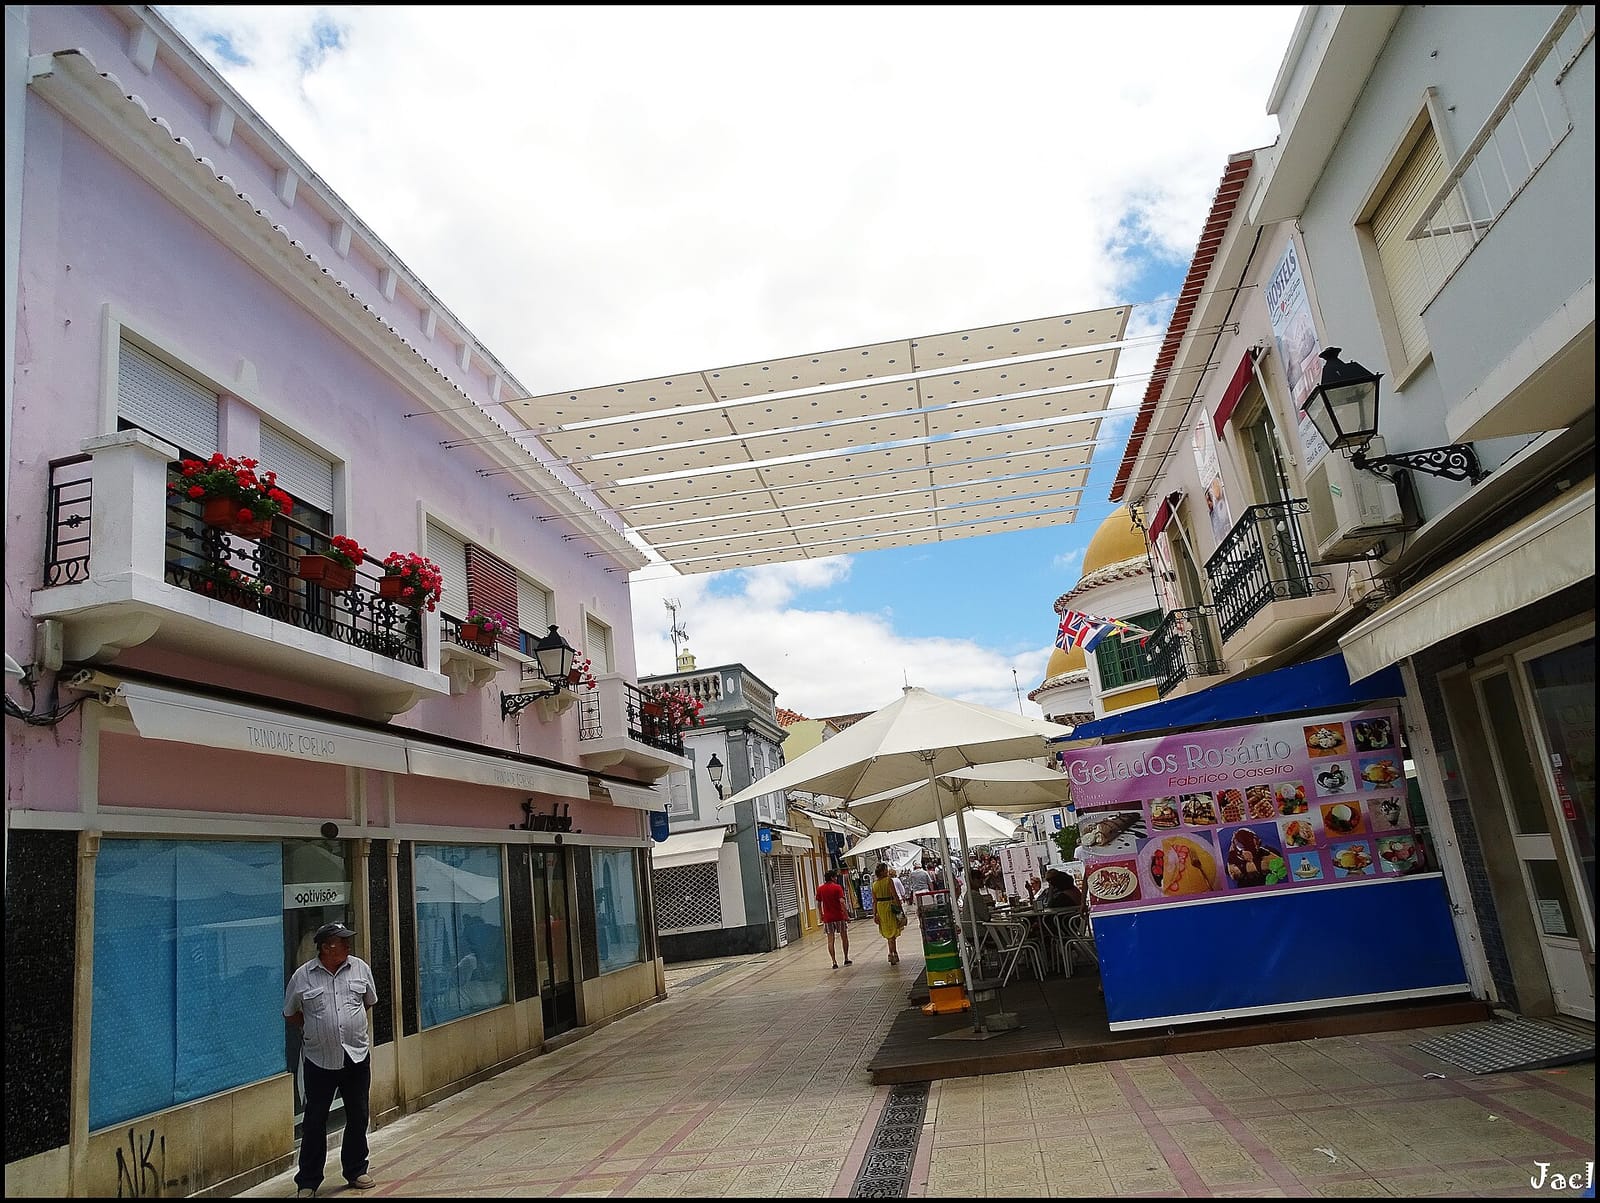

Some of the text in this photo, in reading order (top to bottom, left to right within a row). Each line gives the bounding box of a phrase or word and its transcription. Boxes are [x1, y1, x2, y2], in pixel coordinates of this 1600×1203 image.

[1266, 248, 1297, 317] HOSTELS
[246, 726, 336, 757] TRINDADE COELHO
[1068, 737, 1292, 786] Gelados Rosário
[1168, 763, 1294, 788] Fabrico Caseiro
[294, 888, 338, 906] optivisão
